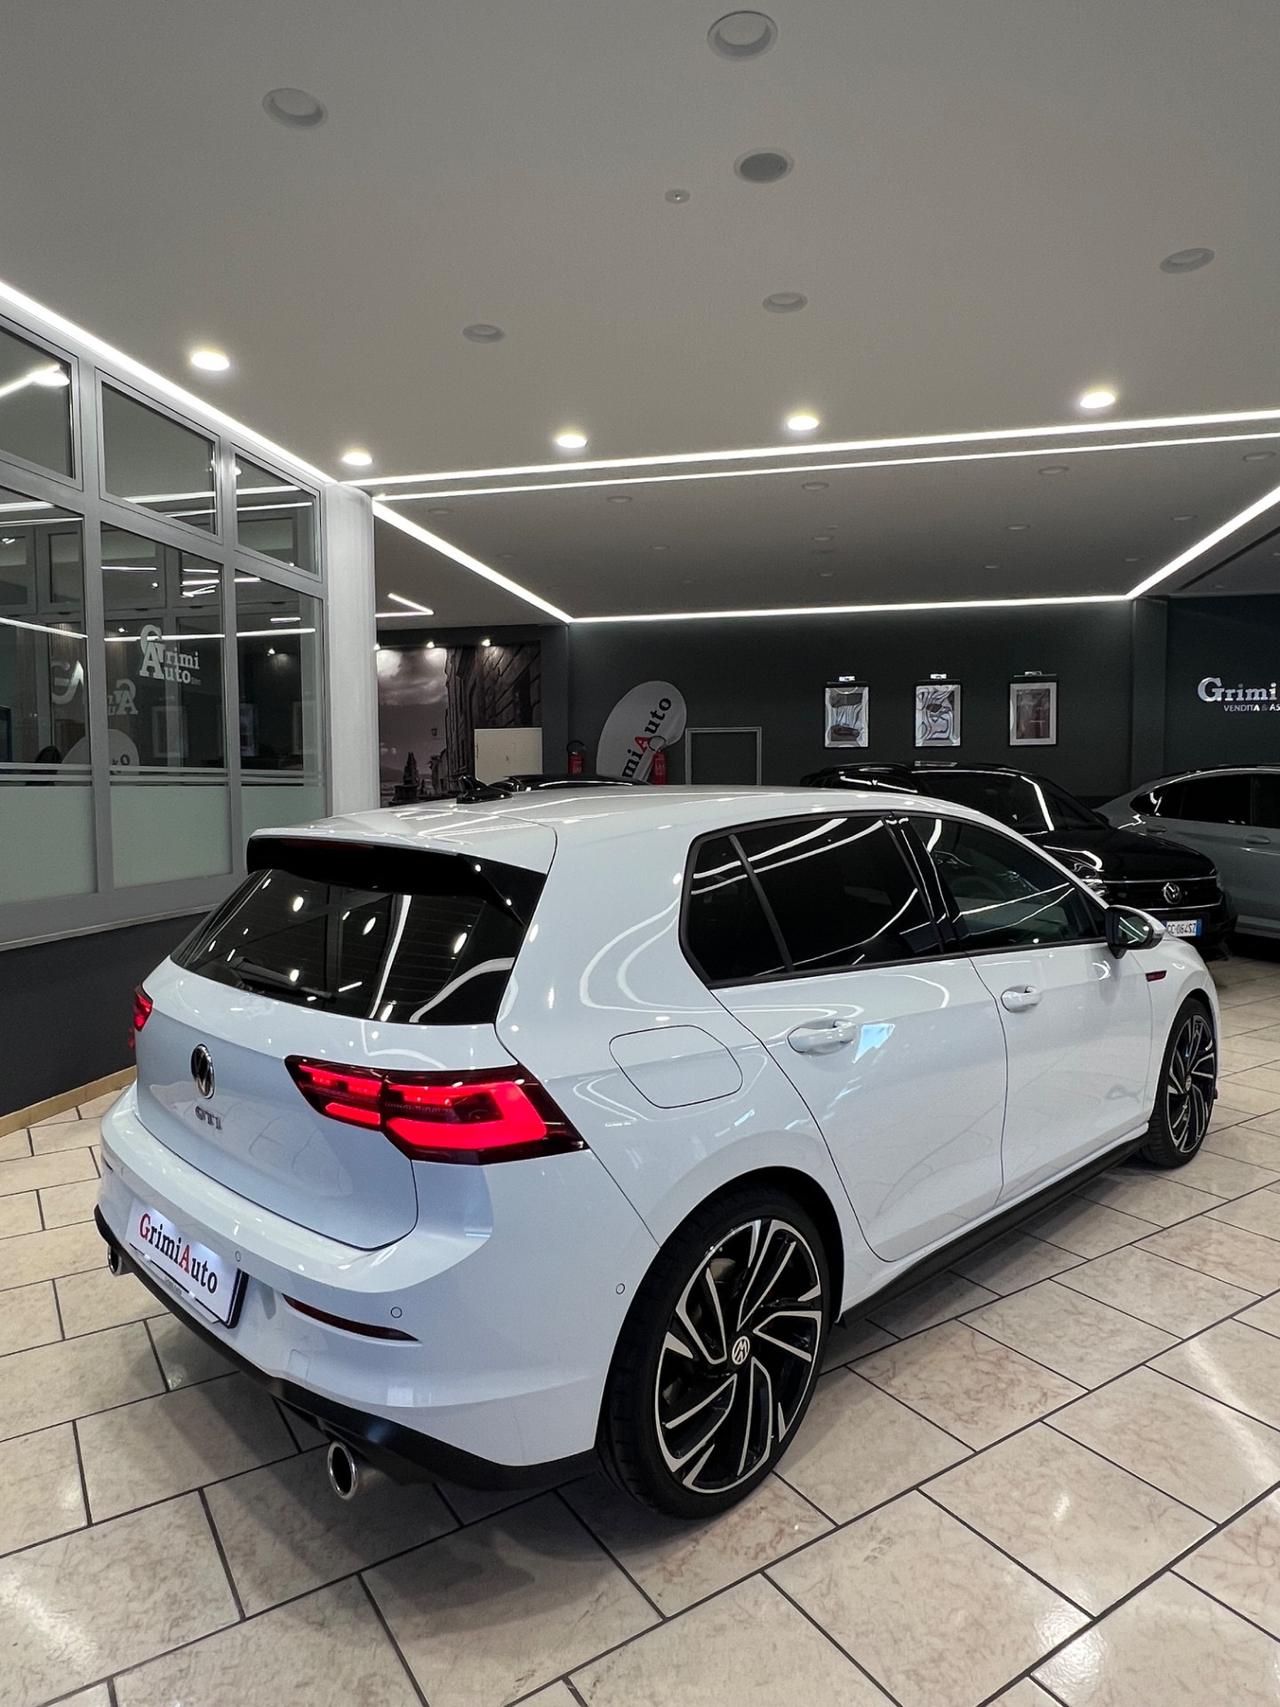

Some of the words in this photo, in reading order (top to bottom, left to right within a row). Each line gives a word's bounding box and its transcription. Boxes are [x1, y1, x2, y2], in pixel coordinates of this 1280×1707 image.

[139, 643, 192, 684] Auto
[1197, 676, 1277, 702] Grimi
[1224, 704, 1260, 712] VENDITA
[195, 1106, 222, 1130] GTI
[139, 1213, 218, 1294] GrimiAuto
